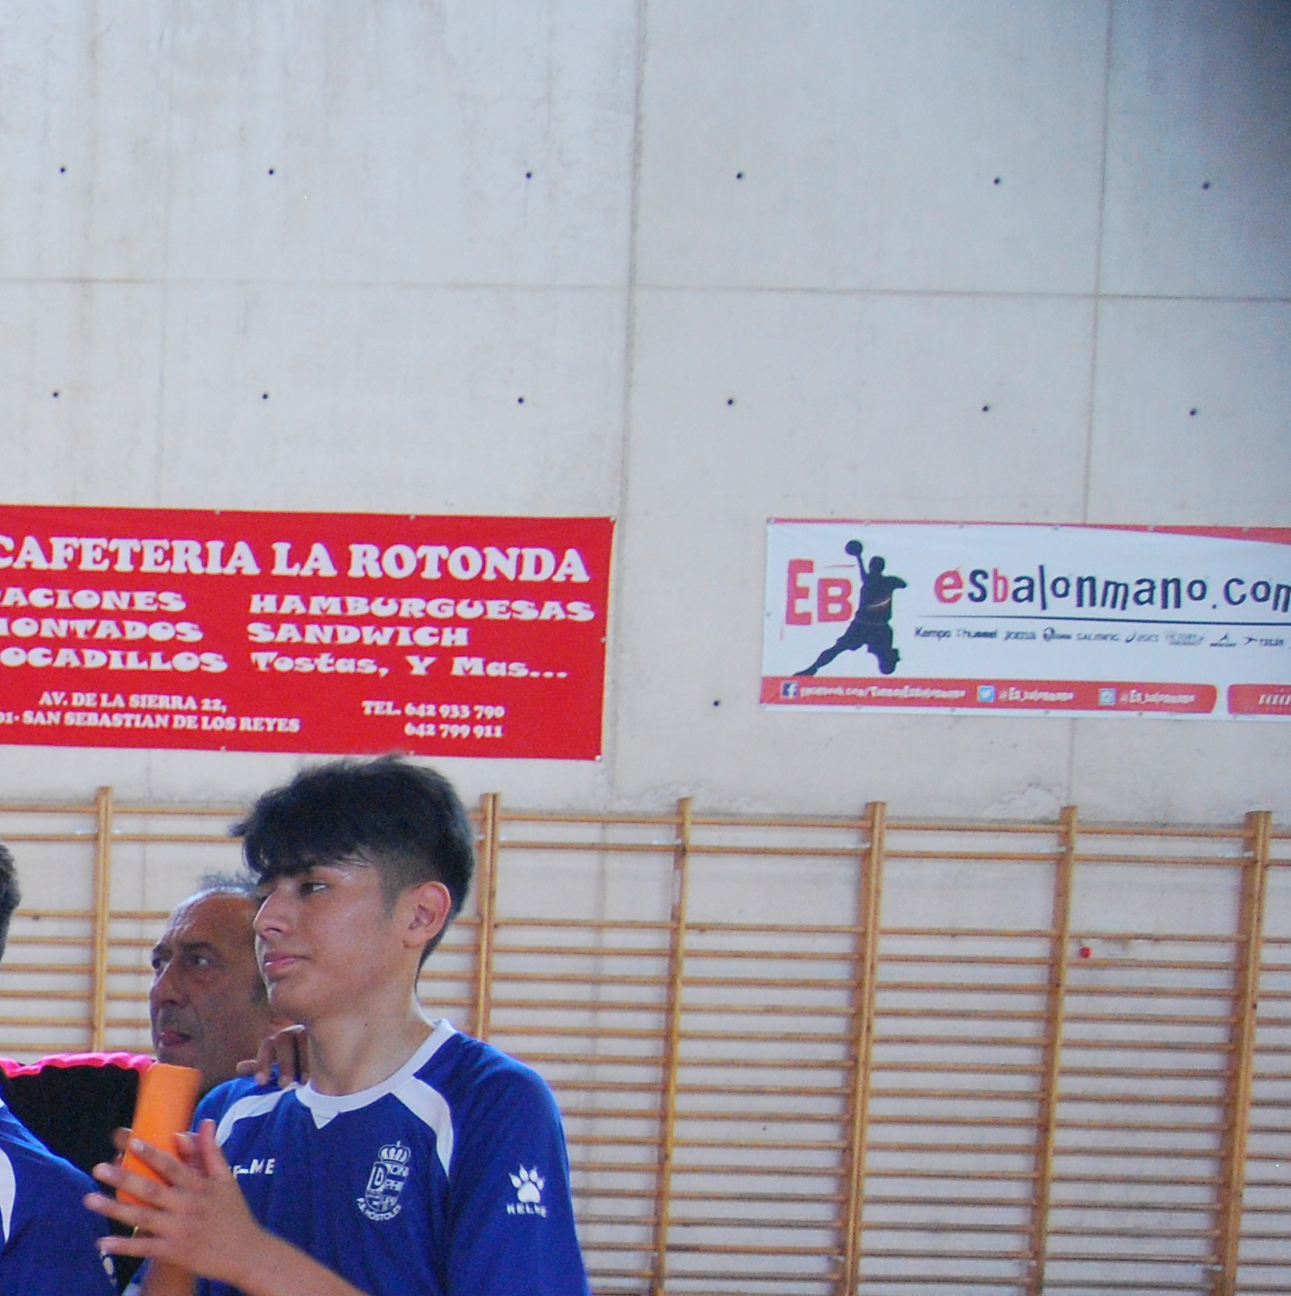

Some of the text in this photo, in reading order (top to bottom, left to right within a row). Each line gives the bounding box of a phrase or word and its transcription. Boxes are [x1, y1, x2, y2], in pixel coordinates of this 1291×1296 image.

[271, 542, 337, 578] LA
[348, 543, 590, 583] ROTONDA
[785, 558, 854, 626] EB
[249, 594, 595, 623] HAMBURGUESAS
[246, 622, 470, 647] SANDWICH
[250, 652, 390, 678] Tostas,
[406, 655, 436, 676] Y
[39, 691, 68, 707] AV.
[72, 692, 98, 707] DE
[101, 693, 125, 709] LA
[129, 694, 198, 711] SIERRA
[361, 700, 401, 715] TEL.
[404, 702, 437, 718] 642
[473, 705, 505, 720] 790
[23, 710, 61, 725] SAN
[64, 711, 170, 729] SEBASTIAN
[173, 714, 199, 730] DE
[202, 714, 237, 730] LOS
[239, 717, 300, 733] REYES
[404, 722, 504, 739] 642 799 911
